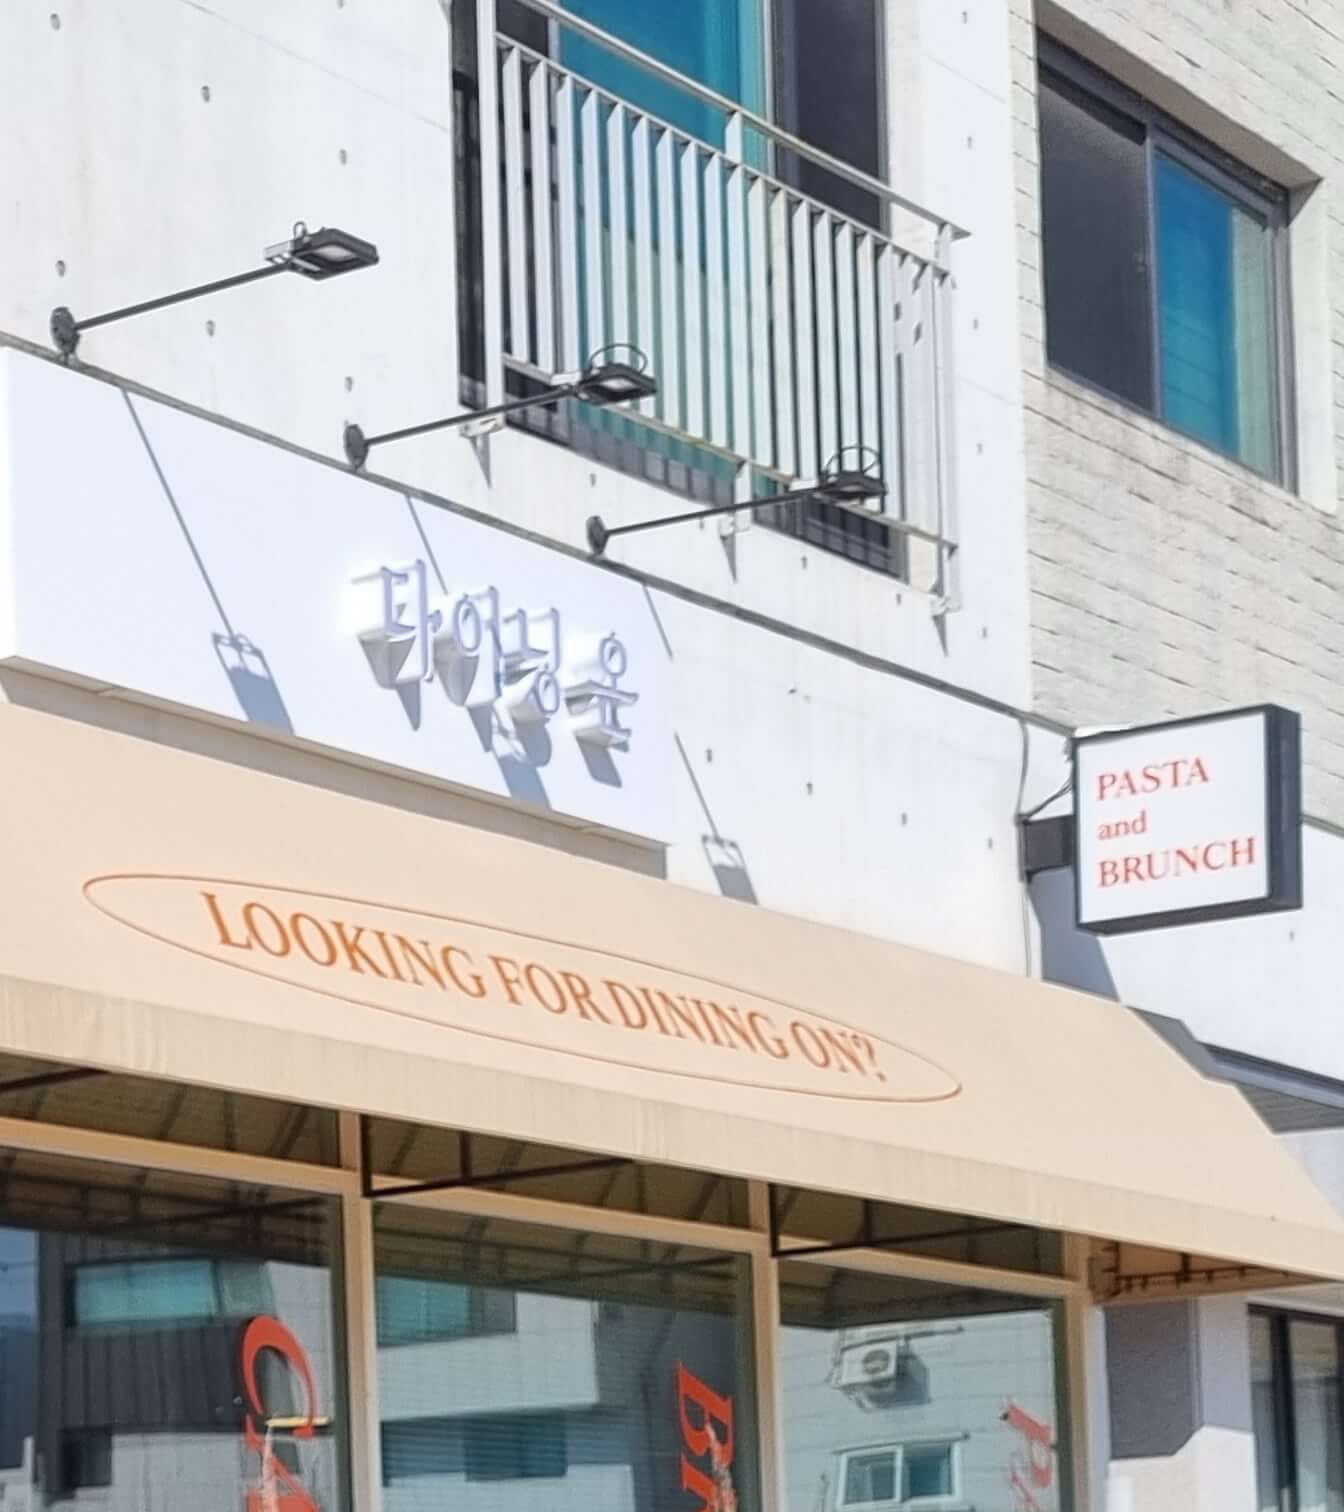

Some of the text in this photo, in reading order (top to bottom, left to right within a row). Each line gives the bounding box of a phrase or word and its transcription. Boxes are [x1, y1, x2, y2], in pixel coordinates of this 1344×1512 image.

[1096, 756, 1210, 801] PASTA
[1098, 808, 1148, 841] and
[1098, 836, 1258, 888] BRUNCH
[201, 890, 888, 1083] LOOKING FOR DINING ON?
